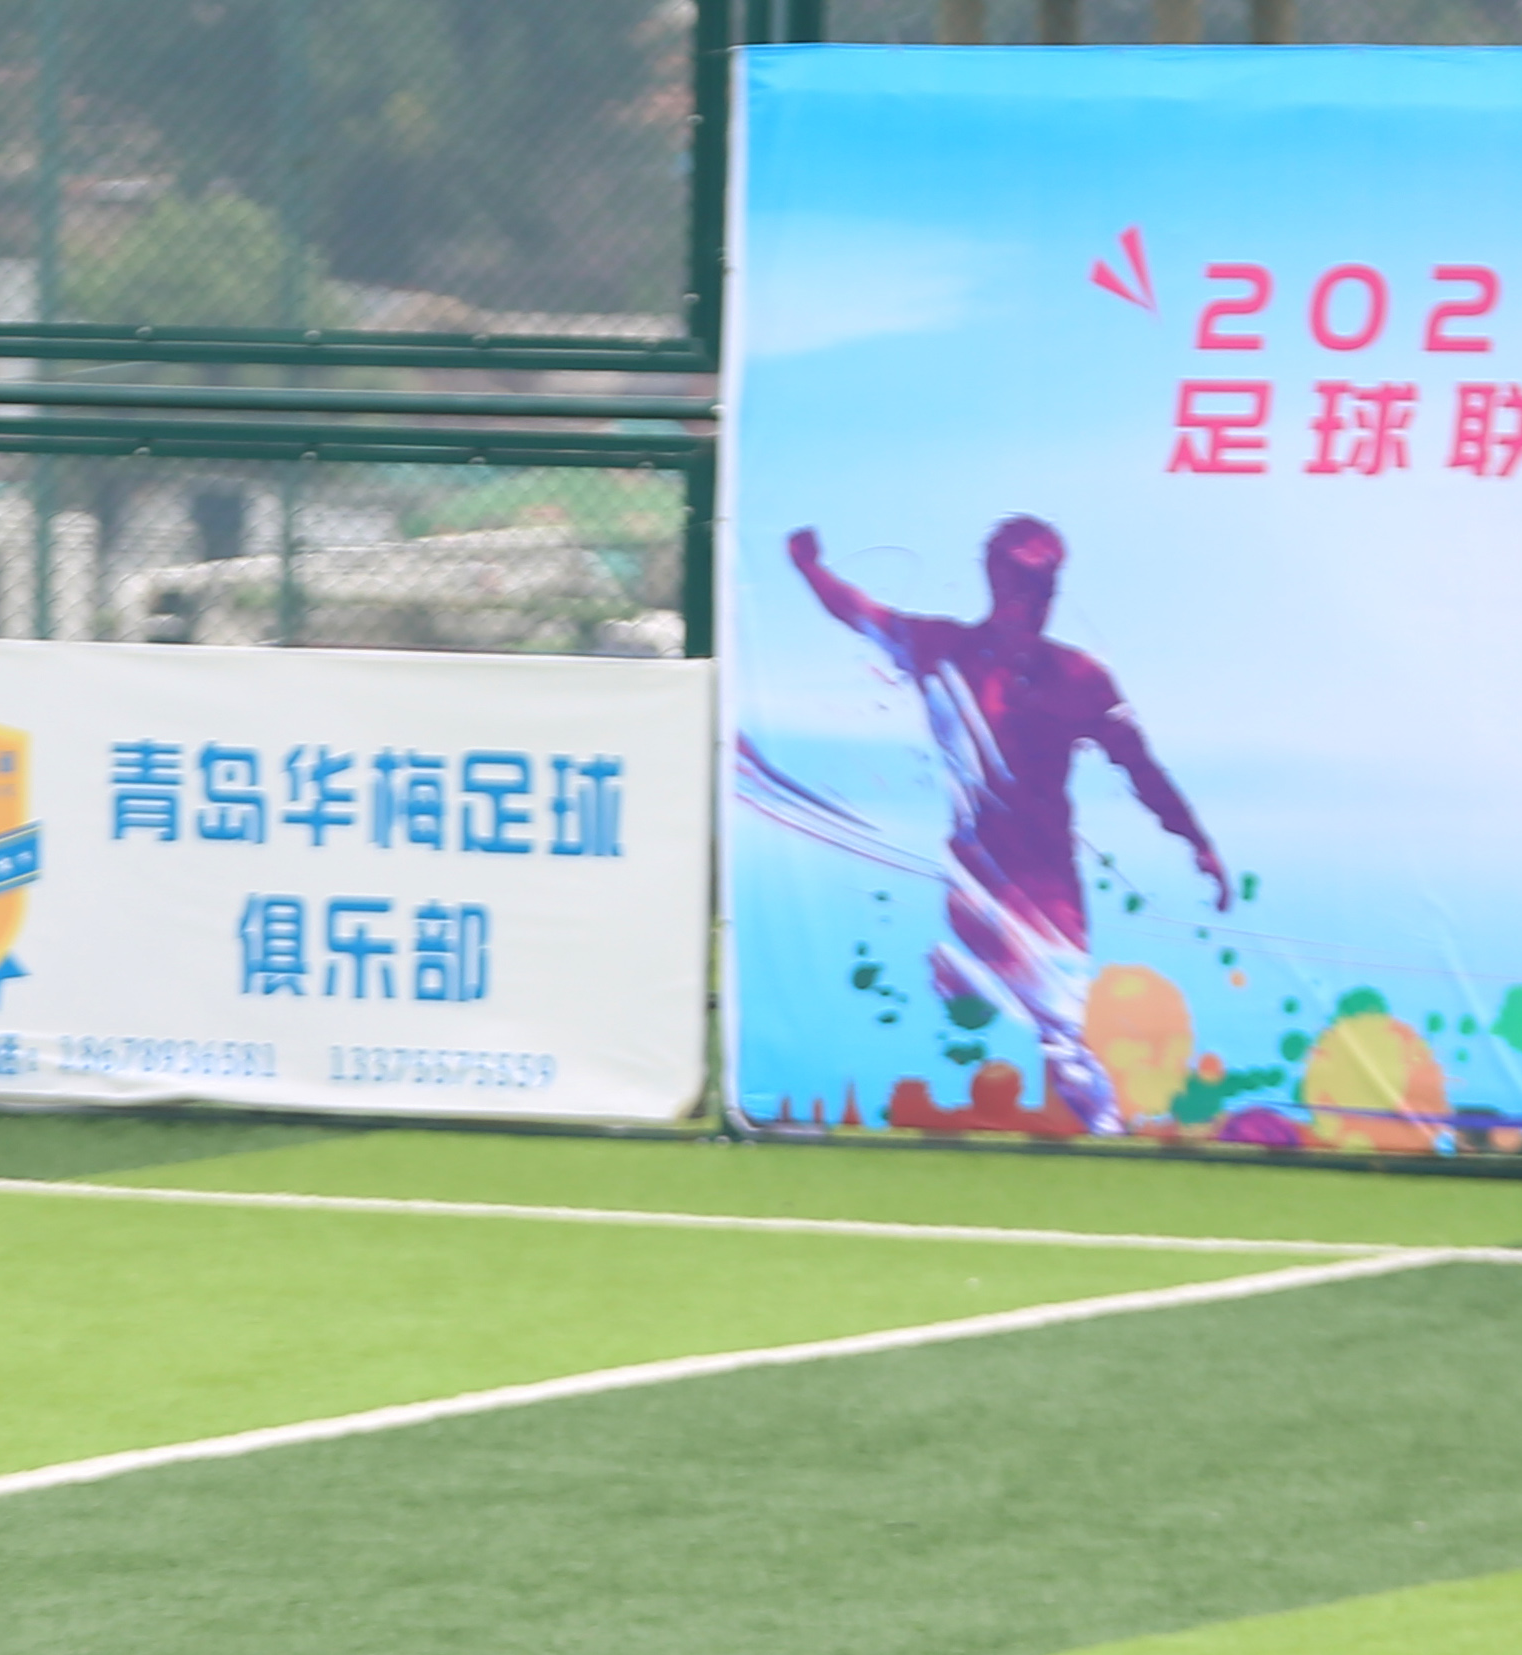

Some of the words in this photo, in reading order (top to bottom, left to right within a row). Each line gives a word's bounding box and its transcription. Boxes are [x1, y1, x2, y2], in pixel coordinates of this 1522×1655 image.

[109, 739, 626, 858] 青岛华梅足球
[236, 891, 490, 1003] 俱乐部
